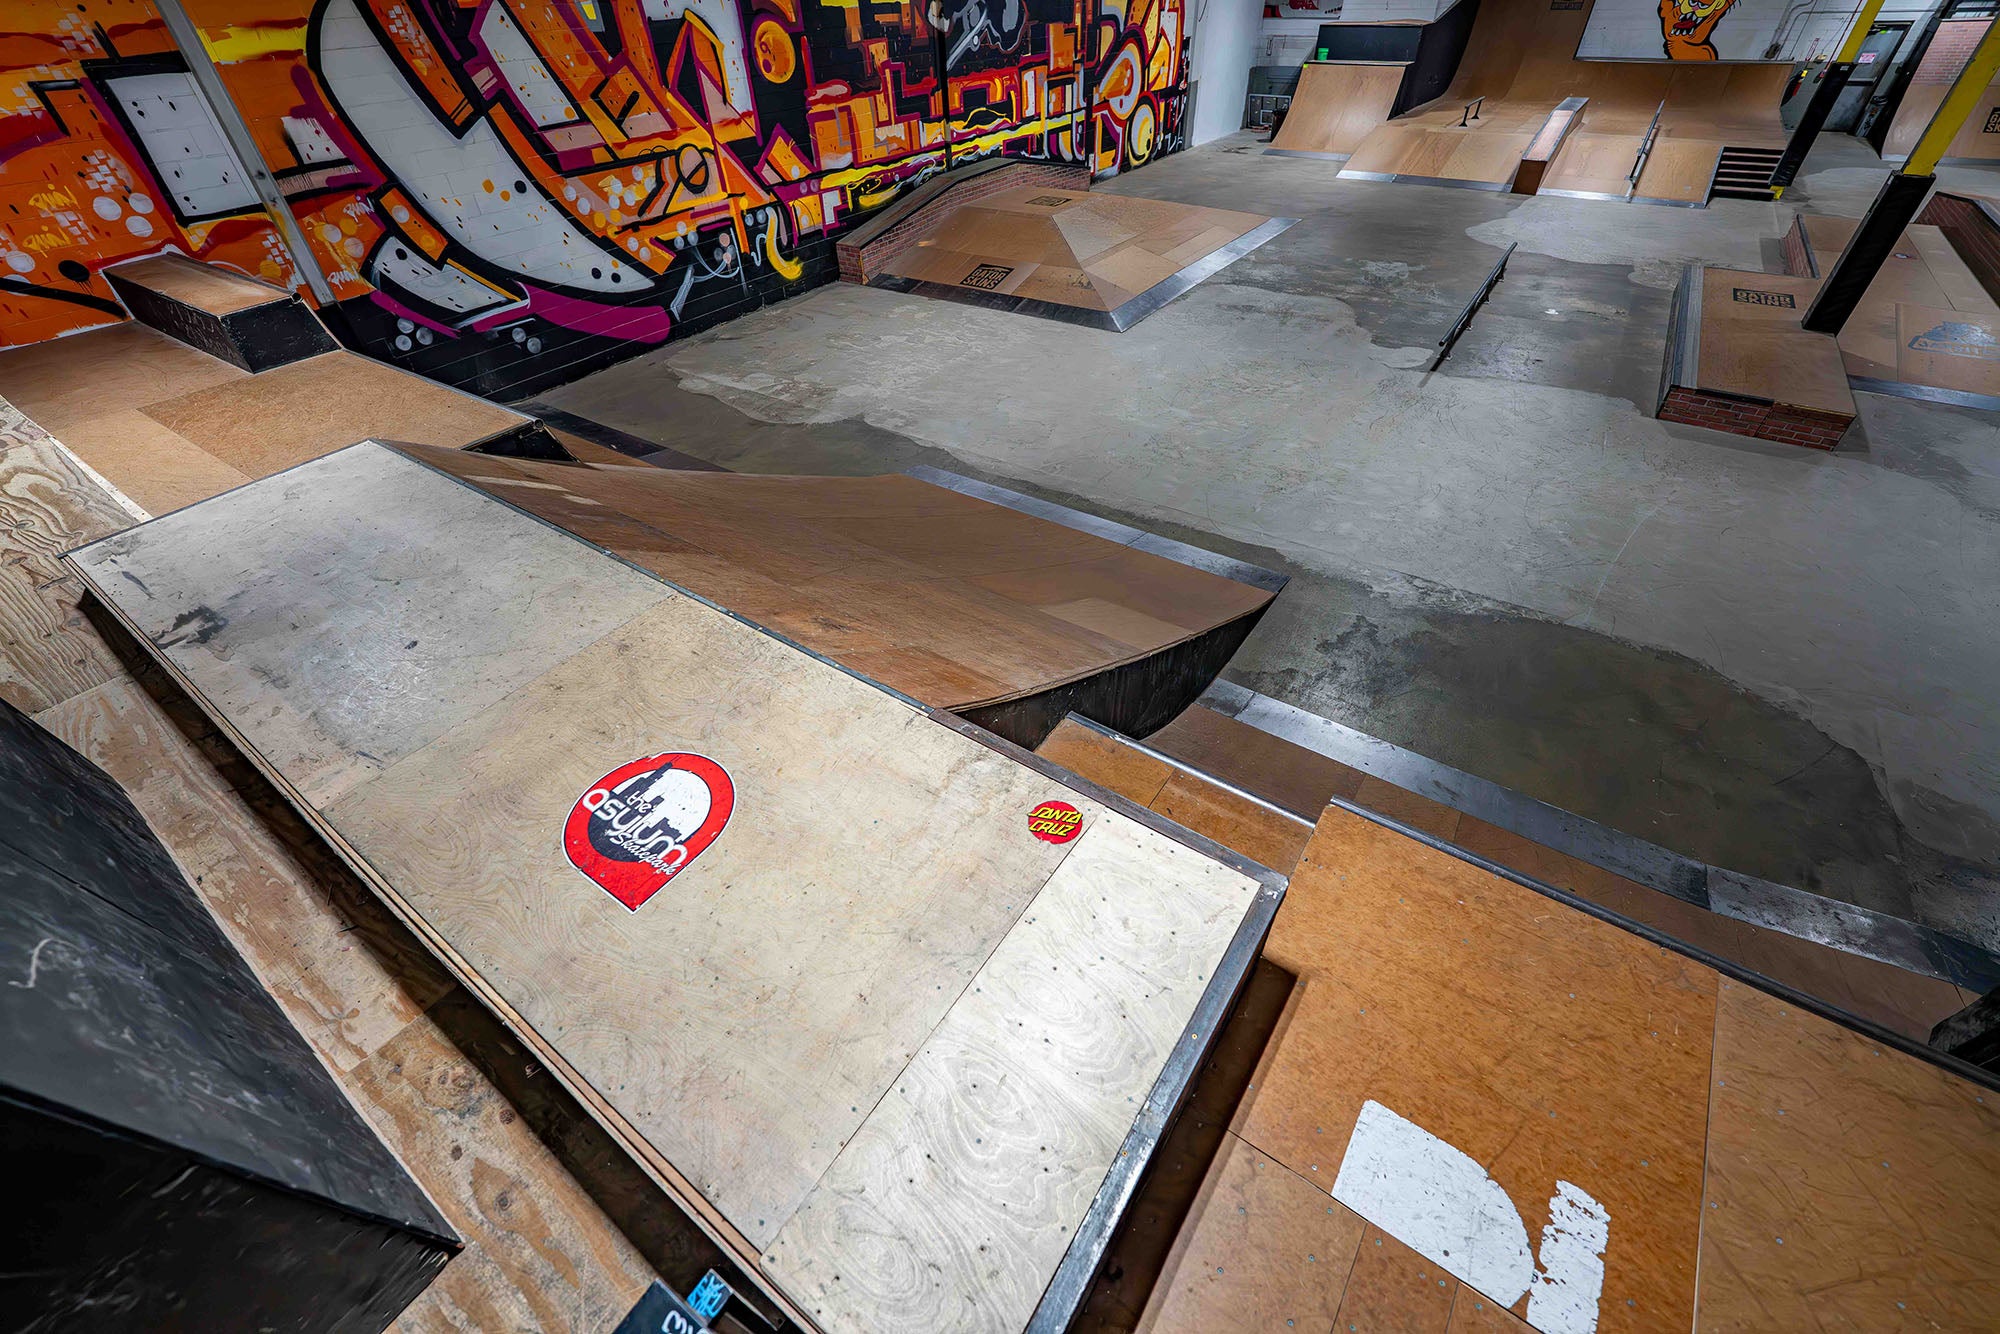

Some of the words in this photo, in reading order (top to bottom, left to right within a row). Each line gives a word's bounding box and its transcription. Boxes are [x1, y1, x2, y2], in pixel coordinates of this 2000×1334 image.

[962, 275, 999, 289] SKINS
[971, 268, 1007, 281] GATOR
[625, 790, 652, 813] the
[1027, 806, 1083, 824] SANTA
[582, 788, 688, 867] asylum
[1029, 819, 1076, 837] CRUZ
[609, 831, 681, 876] Skatepark
